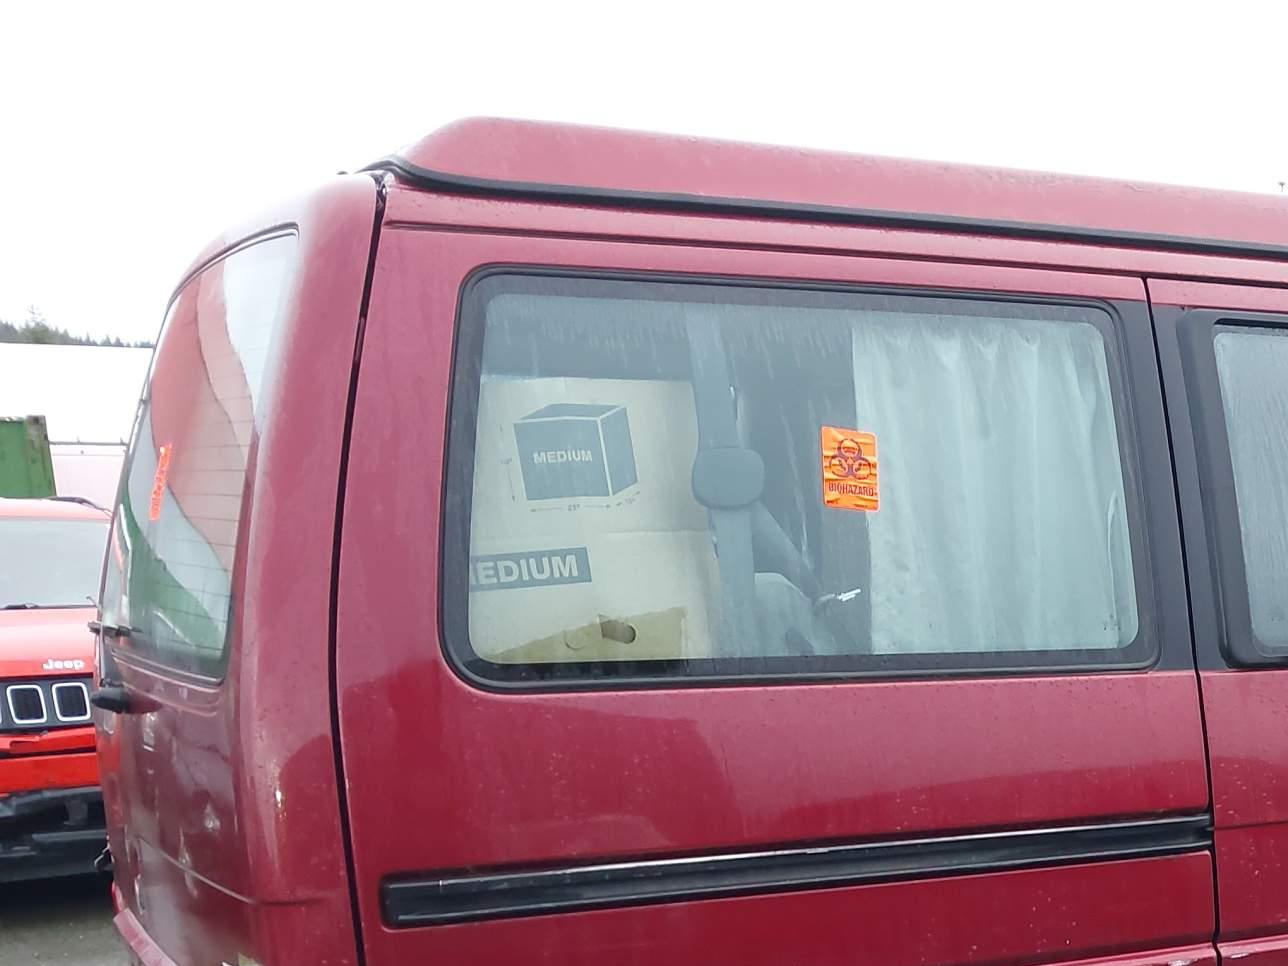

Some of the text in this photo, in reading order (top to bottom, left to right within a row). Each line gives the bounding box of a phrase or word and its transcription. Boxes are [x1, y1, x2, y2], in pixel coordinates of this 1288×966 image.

[532, 449, 593, 464] MEDIUM
[828, 482, 874, 497] BIOHAZARD
[42, 658, 85, 671] Jeep
